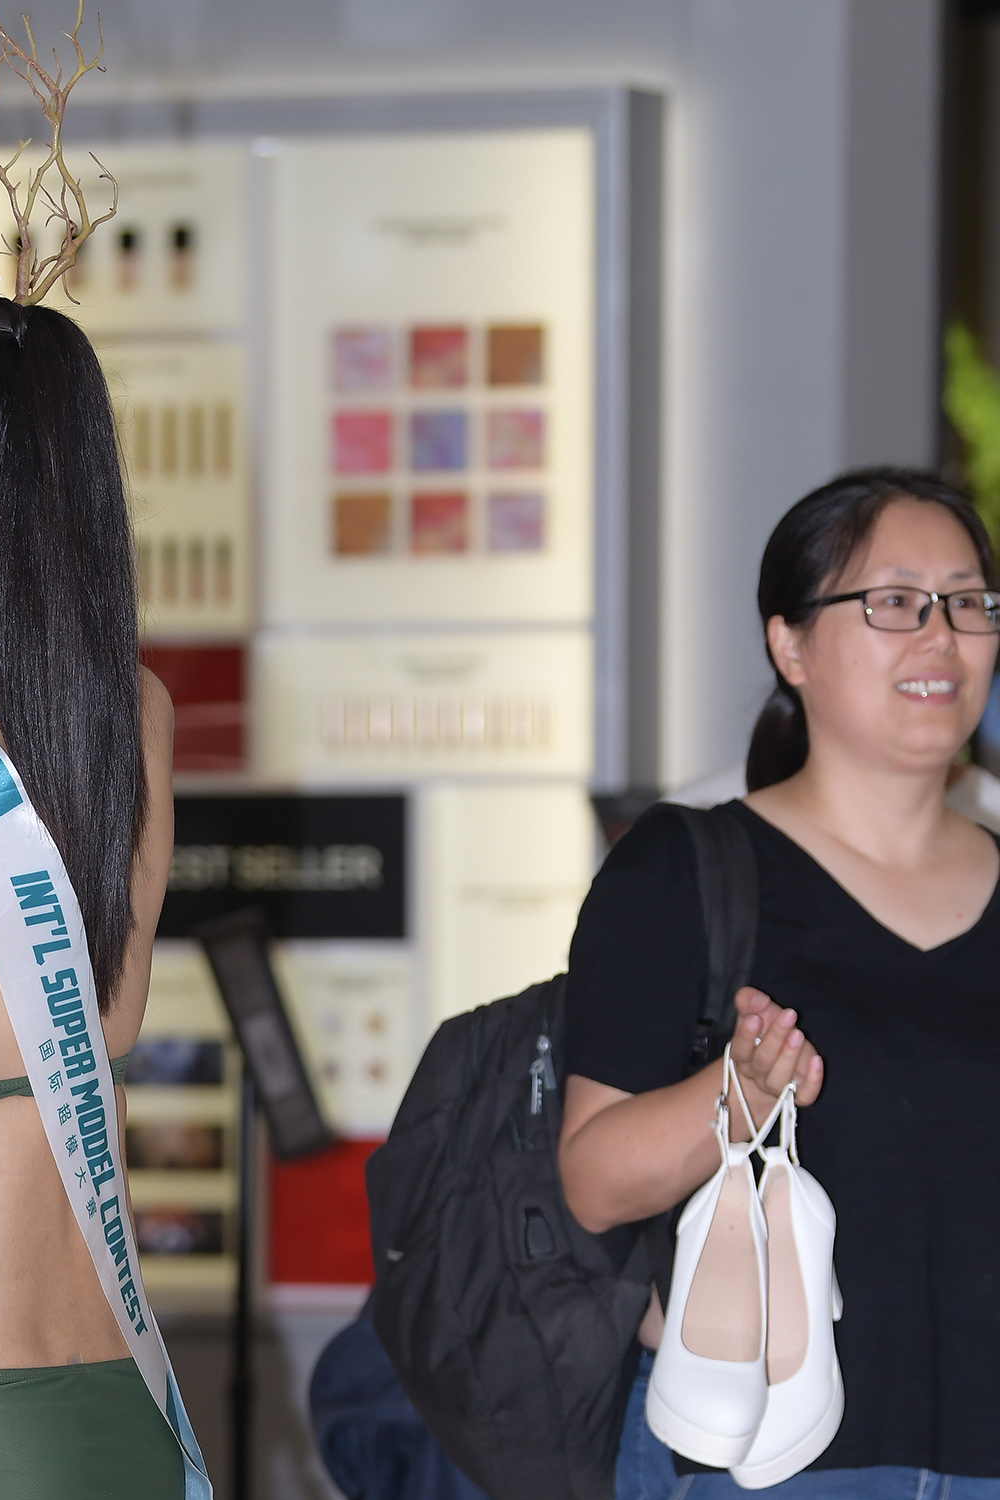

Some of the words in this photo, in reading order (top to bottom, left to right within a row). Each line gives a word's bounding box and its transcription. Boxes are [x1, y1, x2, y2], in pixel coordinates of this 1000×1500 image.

[10, 870, 71, 966] INT'L
[167, 845, 230, 889] EST
[40, 968, 97, 1080] SUPER
[38, 1038, 98, 1220] 国际超模大赛
[70, 1078, 116, 1197] MODEL
[100, 1195, 148, 1336] CONTEST
